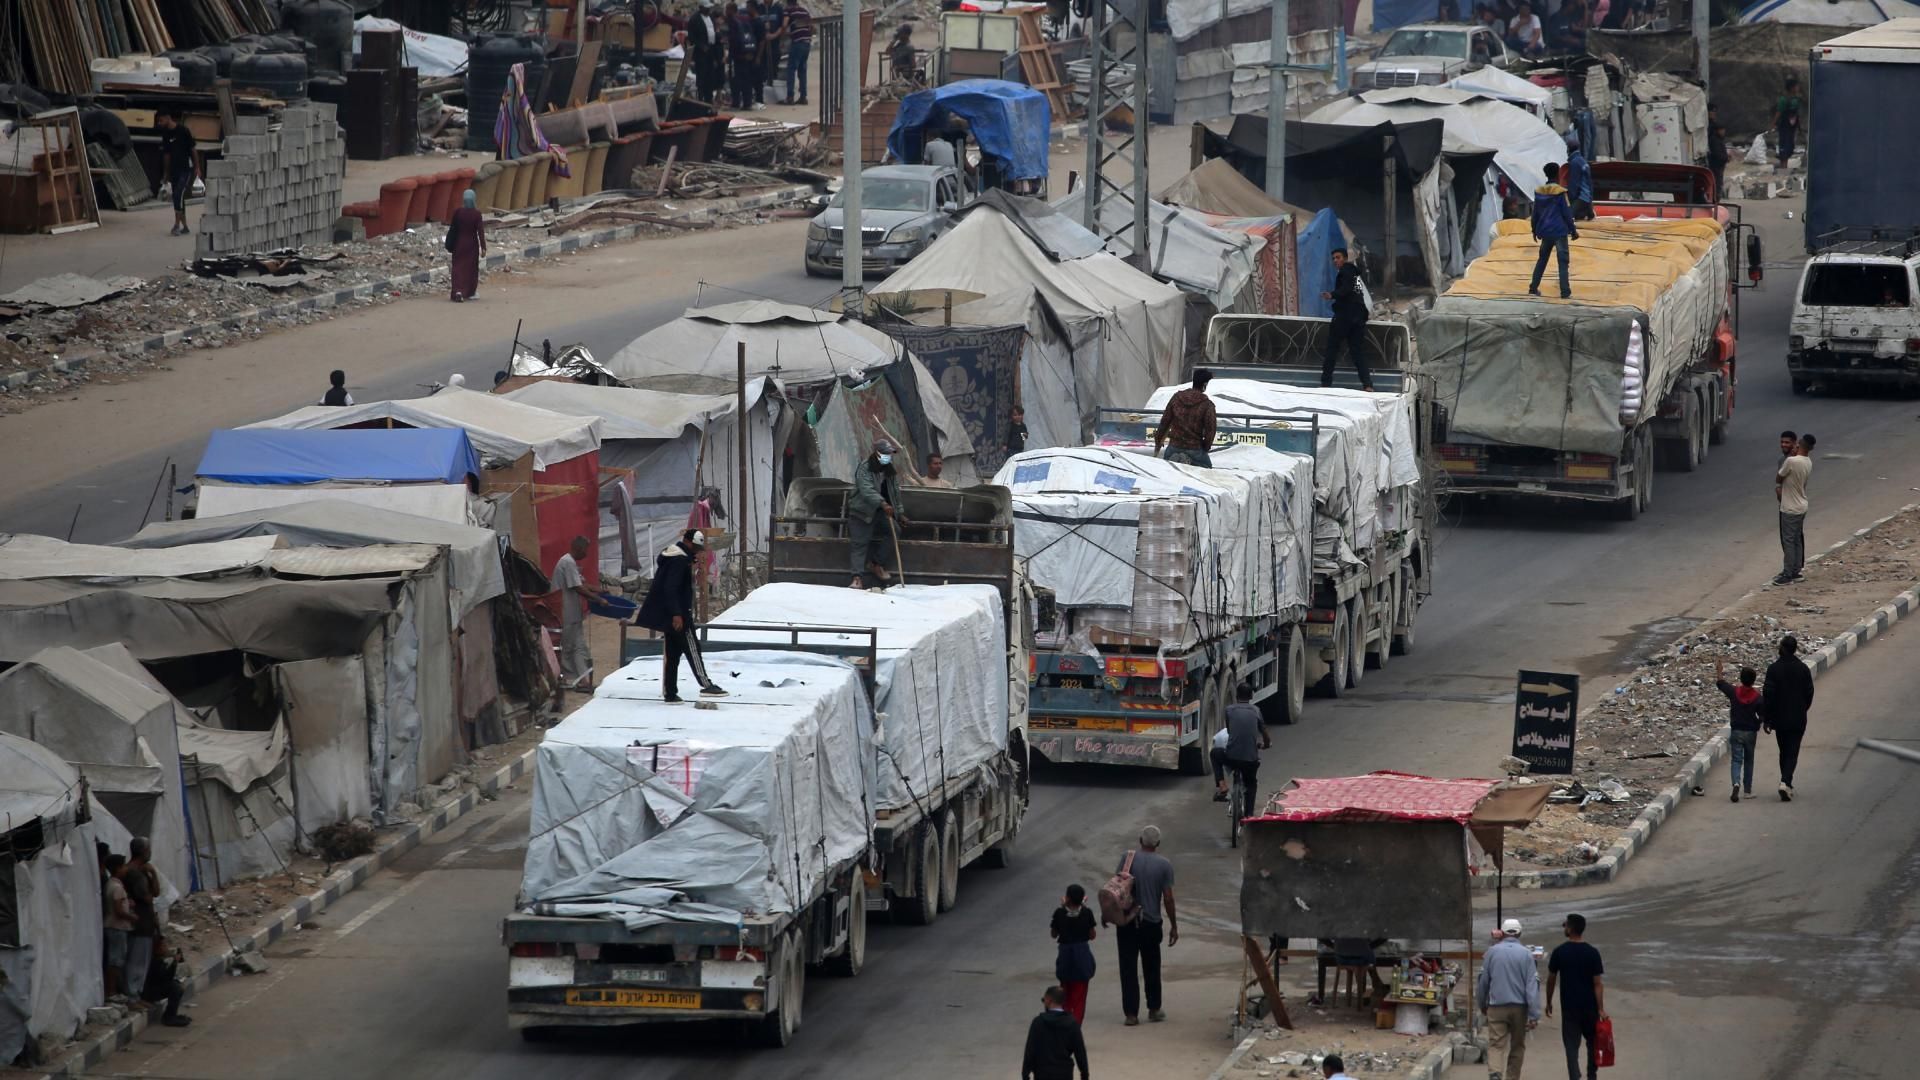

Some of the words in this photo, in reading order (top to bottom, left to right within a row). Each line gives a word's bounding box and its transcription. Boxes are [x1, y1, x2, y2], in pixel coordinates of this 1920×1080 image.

[1519, 702, 1549, 719] صلاح
[1039, 737, 1061, 756] of
[1074, 735, 1102, 753] the
[1105, 740, 1152, 756] road
[647, 993, 665, 1003] רכב
